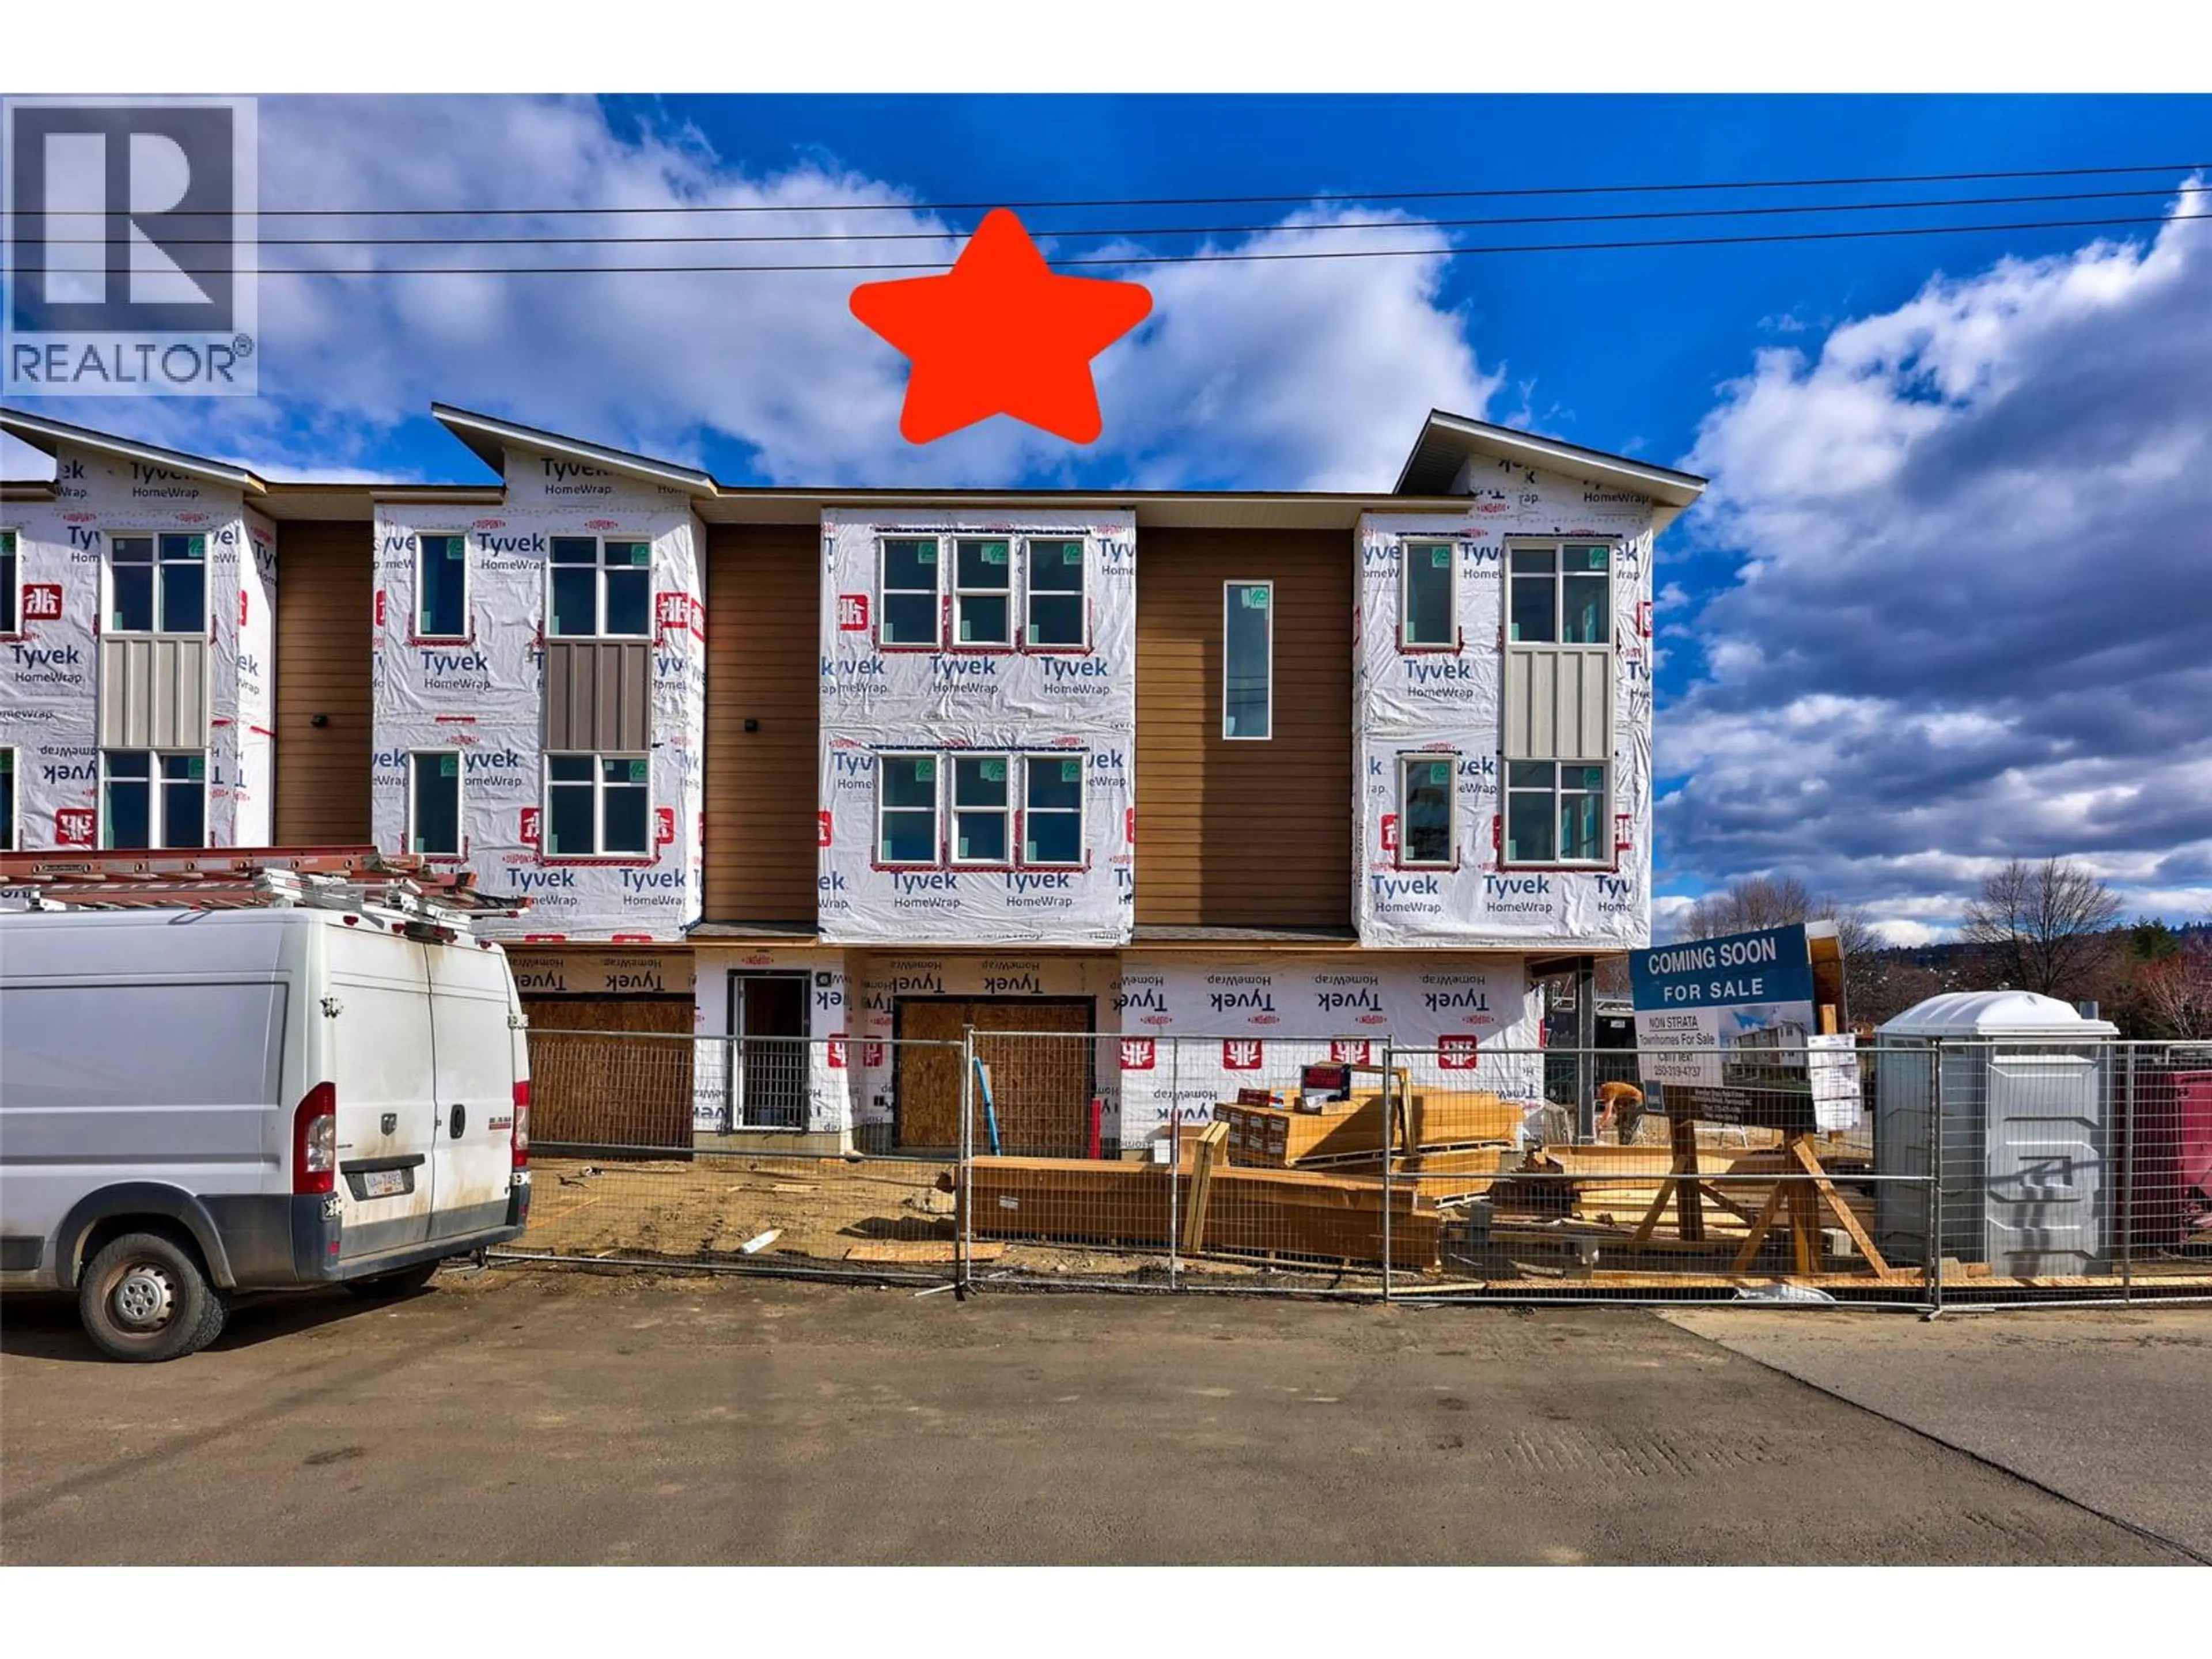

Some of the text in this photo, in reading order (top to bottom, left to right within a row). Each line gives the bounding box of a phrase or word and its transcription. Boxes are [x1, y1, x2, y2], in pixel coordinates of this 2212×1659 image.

[132, 487, 199, 499] HomeWrap
[545, 484, 612, 494] HomeWrap
[1584, 492, 1650, 504] HomeWrap
[477, 533, 546, 556] Tyvek
[10, 645, 79, 669] Tyvek
[421, 652, 488, 675] Tyvek
[929, 655, 996, 679] Tyvek
[15, 672, 82, 683] HomeWrap
[1040, 657, 1108, 681] Tyvek
[1403, 660, 1471, 684] Tyvek
[424, 678, 490, 690] HomeWrap
[933, 683, 999, 695] HomeWrap
[1044, 683, 1111, 695] HomeWrap
[1407, 687, 1474, 699] HomeWrap
[465, 748, 518, 773] yvek
[833, 752, 873, 776] Tyv
[465, 776, 522, 787] omeWrap
[507, 869, 575, 892] Tyvek
[619, 869, 687, 892] Tyvek
[891, 871, 957, 895] Tyvek
[1005, 871, 1069, 894] Tyvek
[1371, 875, 1438, 899] Tyvek
[1482, 875, 1550, 899] Tyvek
[1594, 874, 1632, 899] Tyv
[894, 897, 961, 908] HomeWrap
[1007, 896, 1073, 908] HomeWrap
[1375, 902, 1441, 912] HomeWrap
[1487, 902, 1553, 913] HomeWrap
[1648, 937, 1777, 975] COMING SOON
[607, 971, 665, 991] Tyvek
[984, 974, 1044, 994] Tyvek
[1207, 975, 1271, 986] HomeWrap
[1315, 975, 1378, 986] HomeWrap
[1422, 975, 1486, 986] HomeWrap
[1664, 978, 1764, 1002] FOR SALE
[1210, 988, 1275, 1012] Tyvek
[1318, 988, 1383, 1012] Tyvek
[1425, 988, 1490, 1012] Tyvek
[1649, 1016, 1699, 1028] NON STRATA
[1681, 1033, 1695, 1045] For
[1696, 1033, 1715, 1045] Sale
